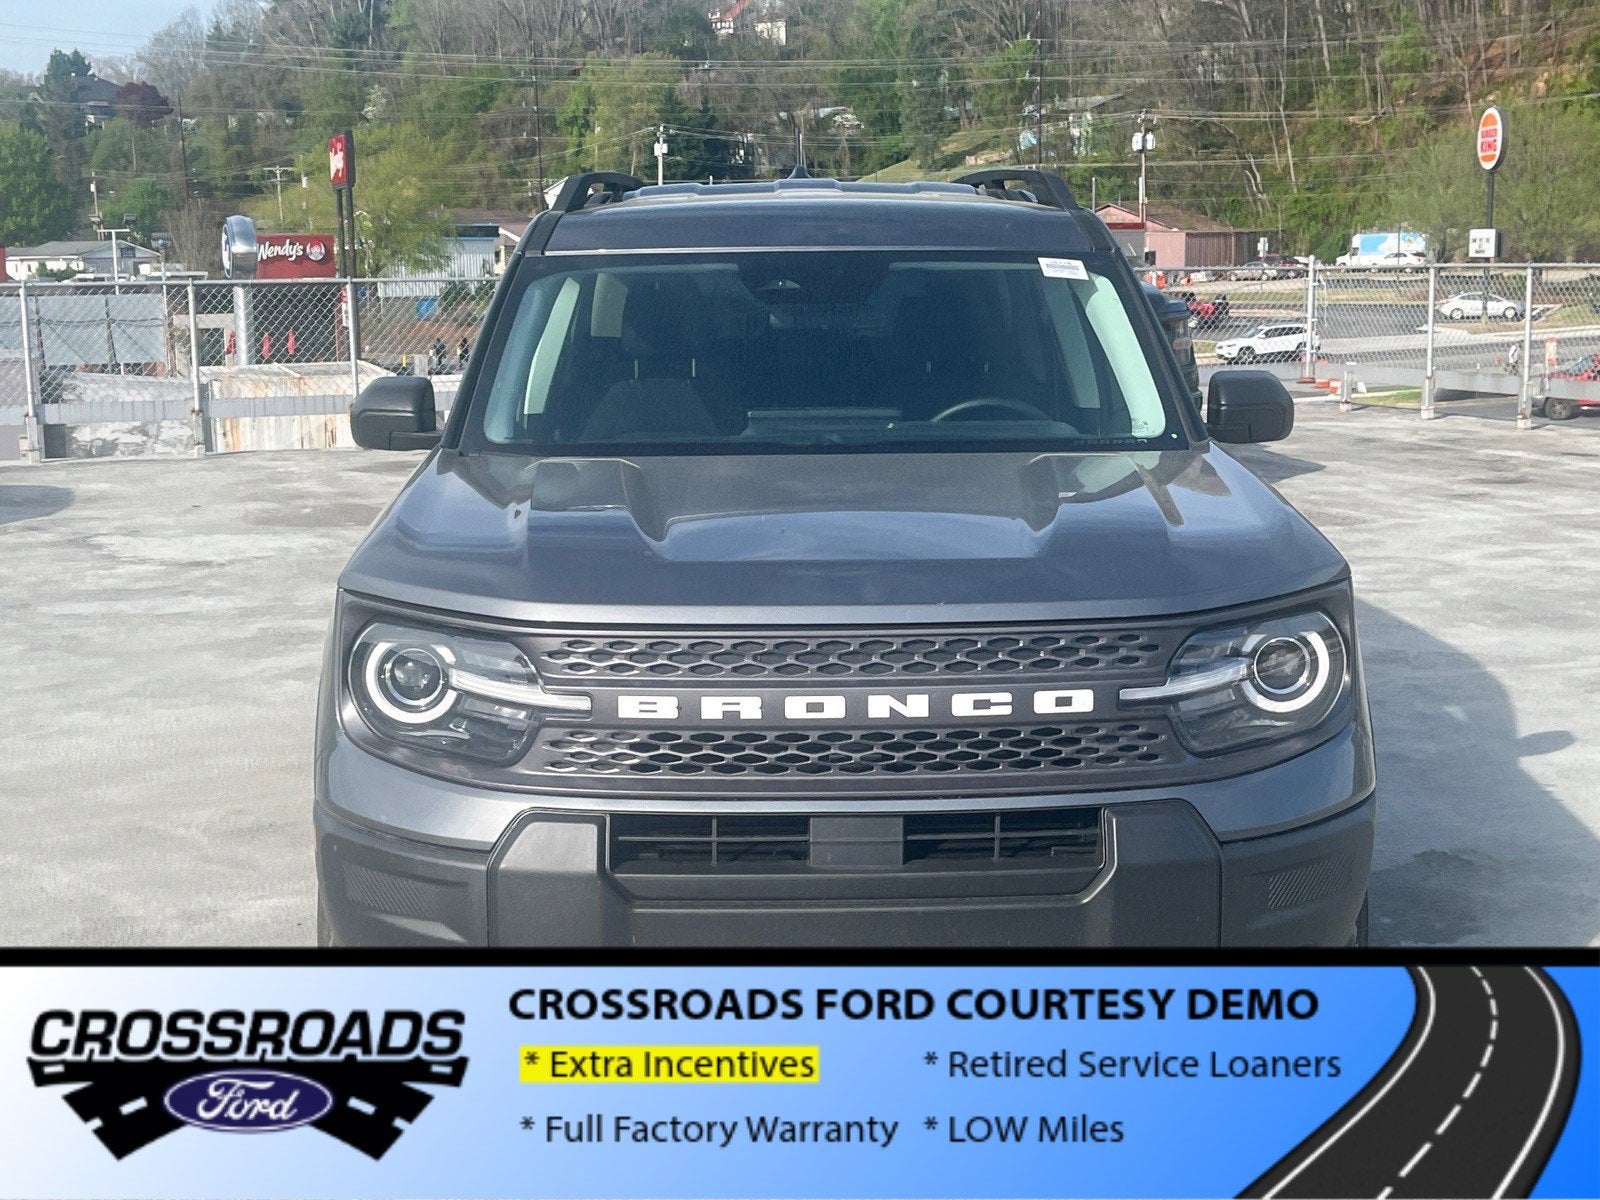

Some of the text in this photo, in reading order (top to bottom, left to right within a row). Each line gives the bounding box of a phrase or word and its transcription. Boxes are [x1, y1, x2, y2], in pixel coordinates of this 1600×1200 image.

[1480, 139, 1497, 151] KING
[256, 238, 304, 262] Wendy's
[617, 689, 1094, 721] BRONCO
